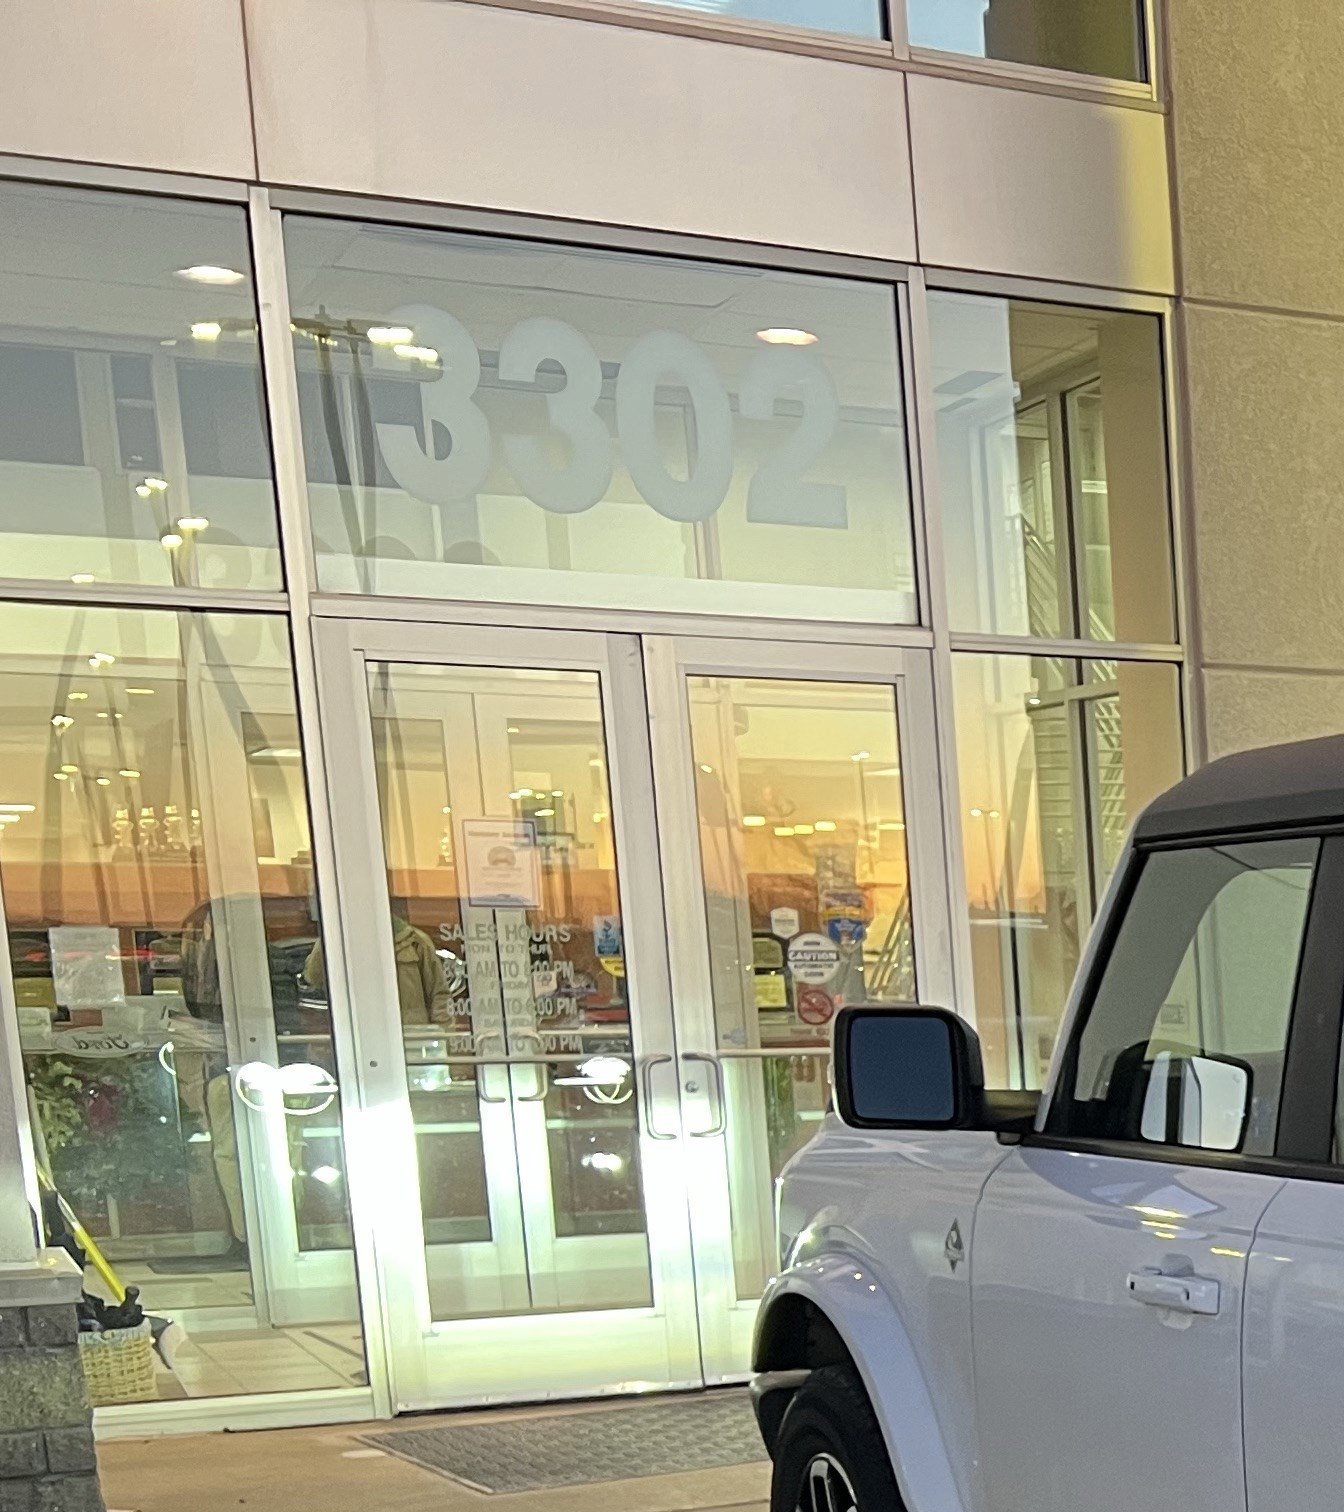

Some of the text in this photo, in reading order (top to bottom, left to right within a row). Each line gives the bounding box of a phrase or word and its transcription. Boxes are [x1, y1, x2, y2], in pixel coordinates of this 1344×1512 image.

[373, 303, 849, 531] 3302
[505, 923, 572, 943] HOURS
[788, 951, 837, 961] CAUTION
[553, 959, 576, 980] PM
[556, 997, 578, 1016] PM
